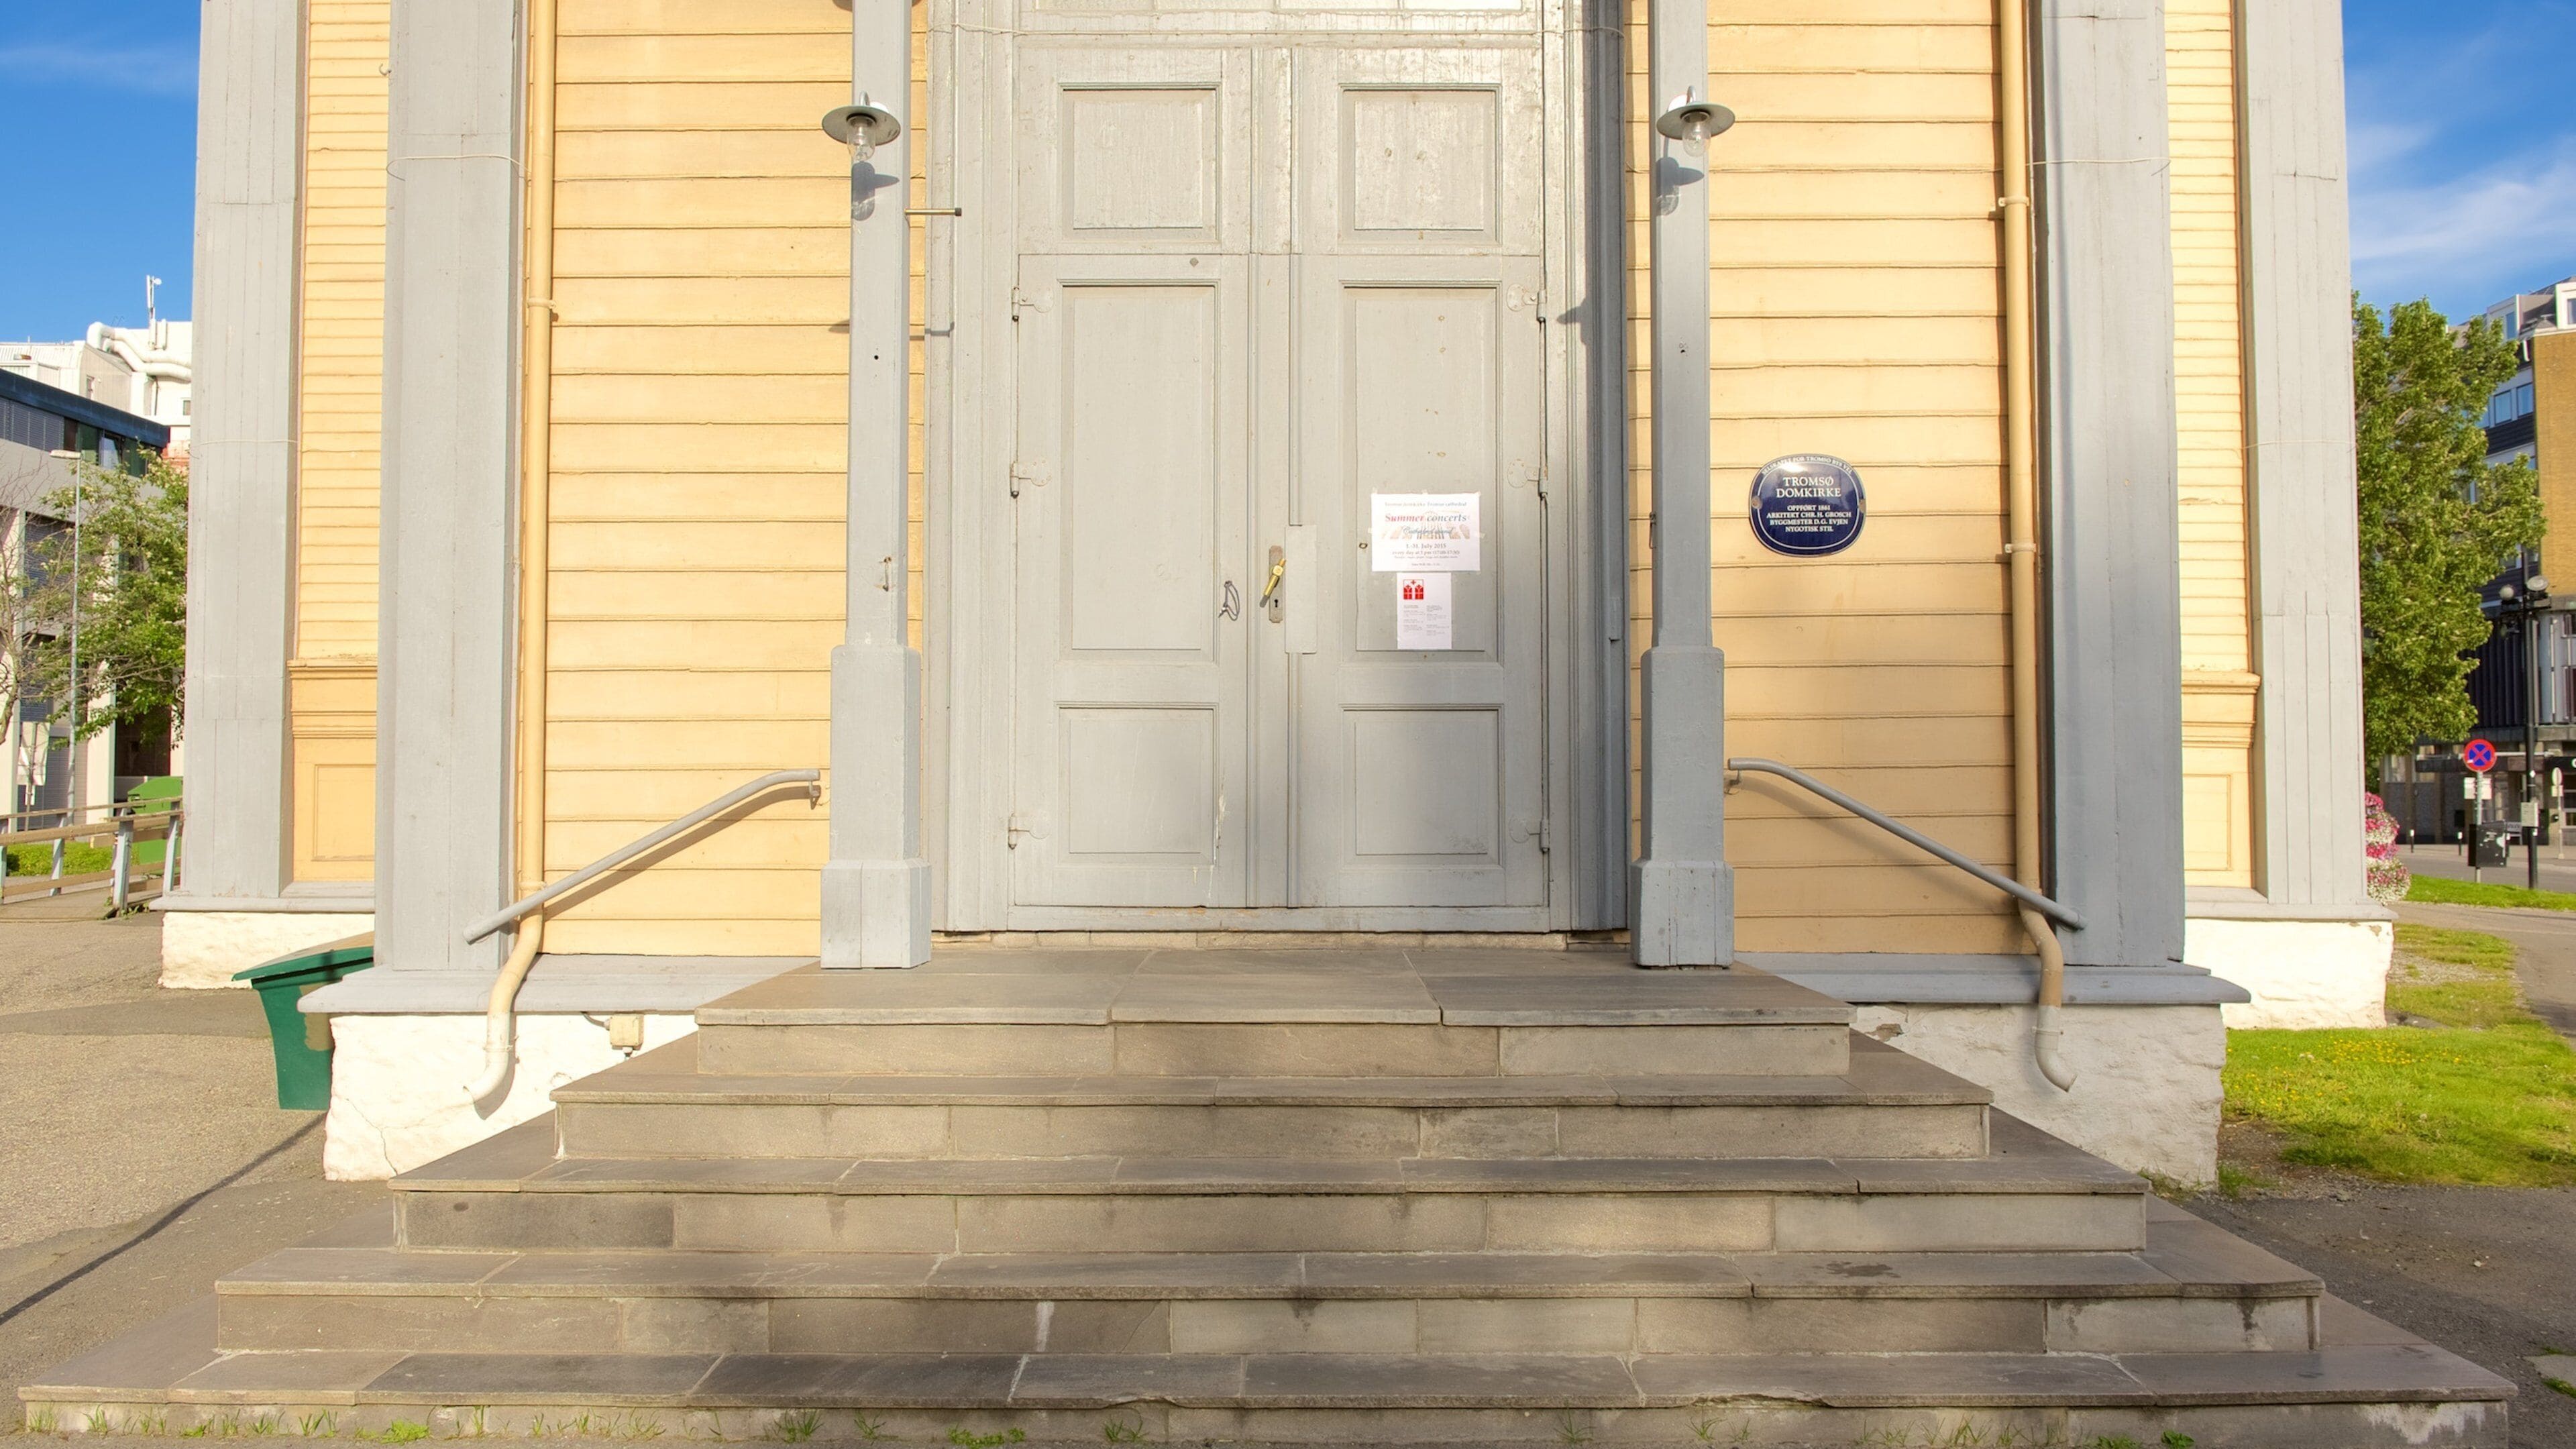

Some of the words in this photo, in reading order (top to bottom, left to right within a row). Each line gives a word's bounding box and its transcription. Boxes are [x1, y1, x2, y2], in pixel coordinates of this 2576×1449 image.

[1843, 464, 1853, 474] VEL
[1782, 476, 1834, 487] TROMSØ
[1776, 488, 1841, 498] DOMKIRKE
[1385, 513, 1425, 522] Summer
[1427, 514, 1467, 522] concerts
